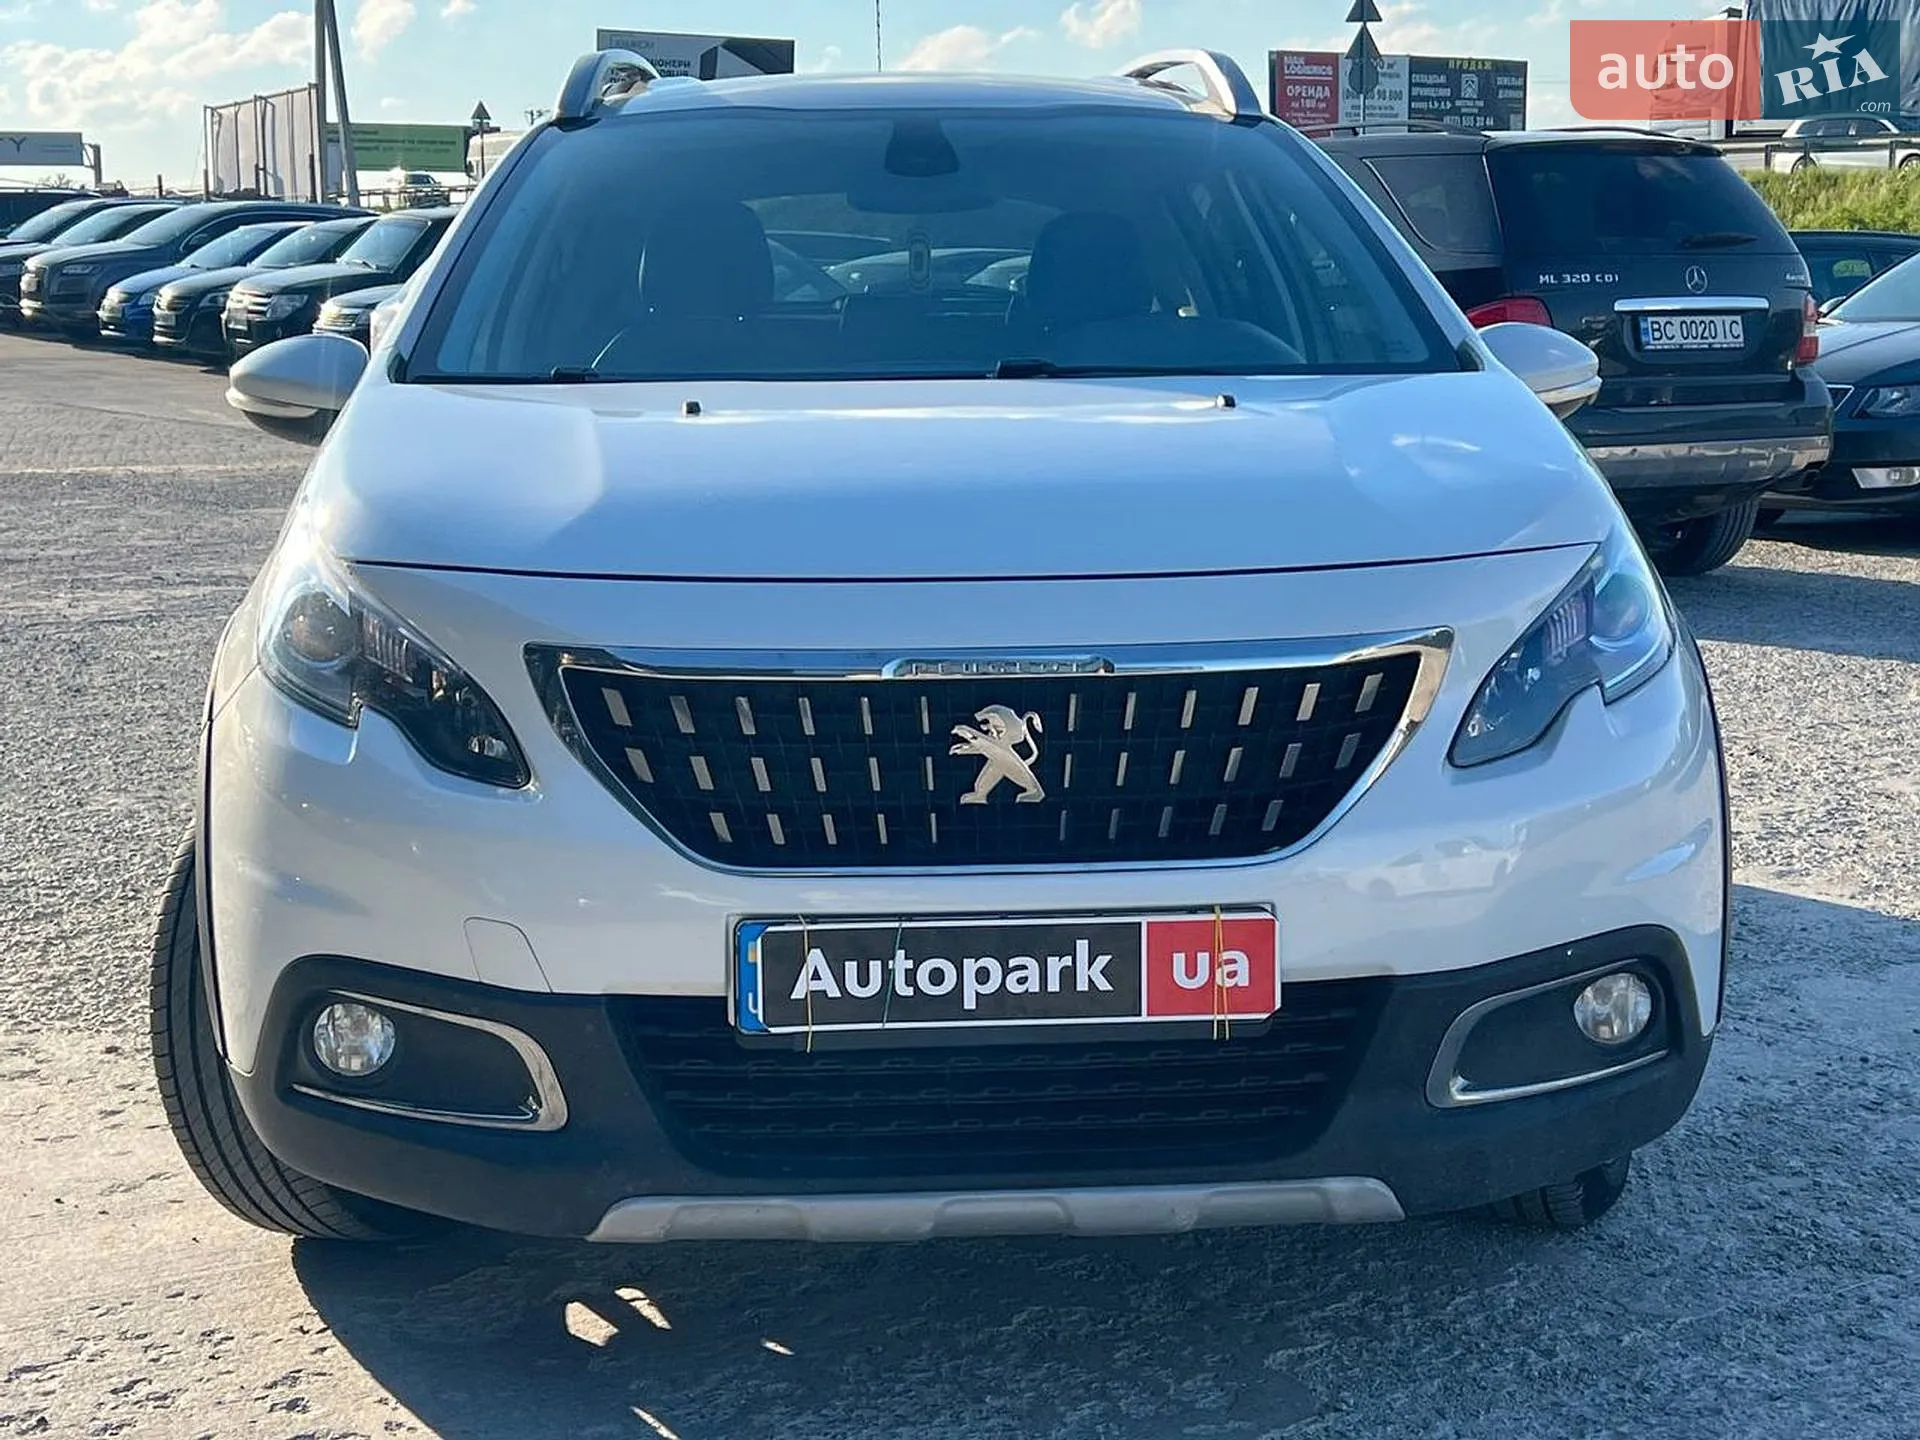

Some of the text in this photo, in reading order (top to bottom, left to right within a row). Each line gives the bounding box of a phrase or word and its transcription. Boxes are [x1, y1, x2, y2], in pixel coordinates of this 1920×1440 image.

[1448, 59, 1493, 71] ПРОДАЖ
[1286, 85, 1332, 99] ОРЕНДА
[1539, 273, 1619, 284] ML 320 CDI
[1650, 319, 1741, 341] BC 0020 IC
[790, 939, 1114, 1010] Autopark
[1172, 947, 1251, 991] ua
